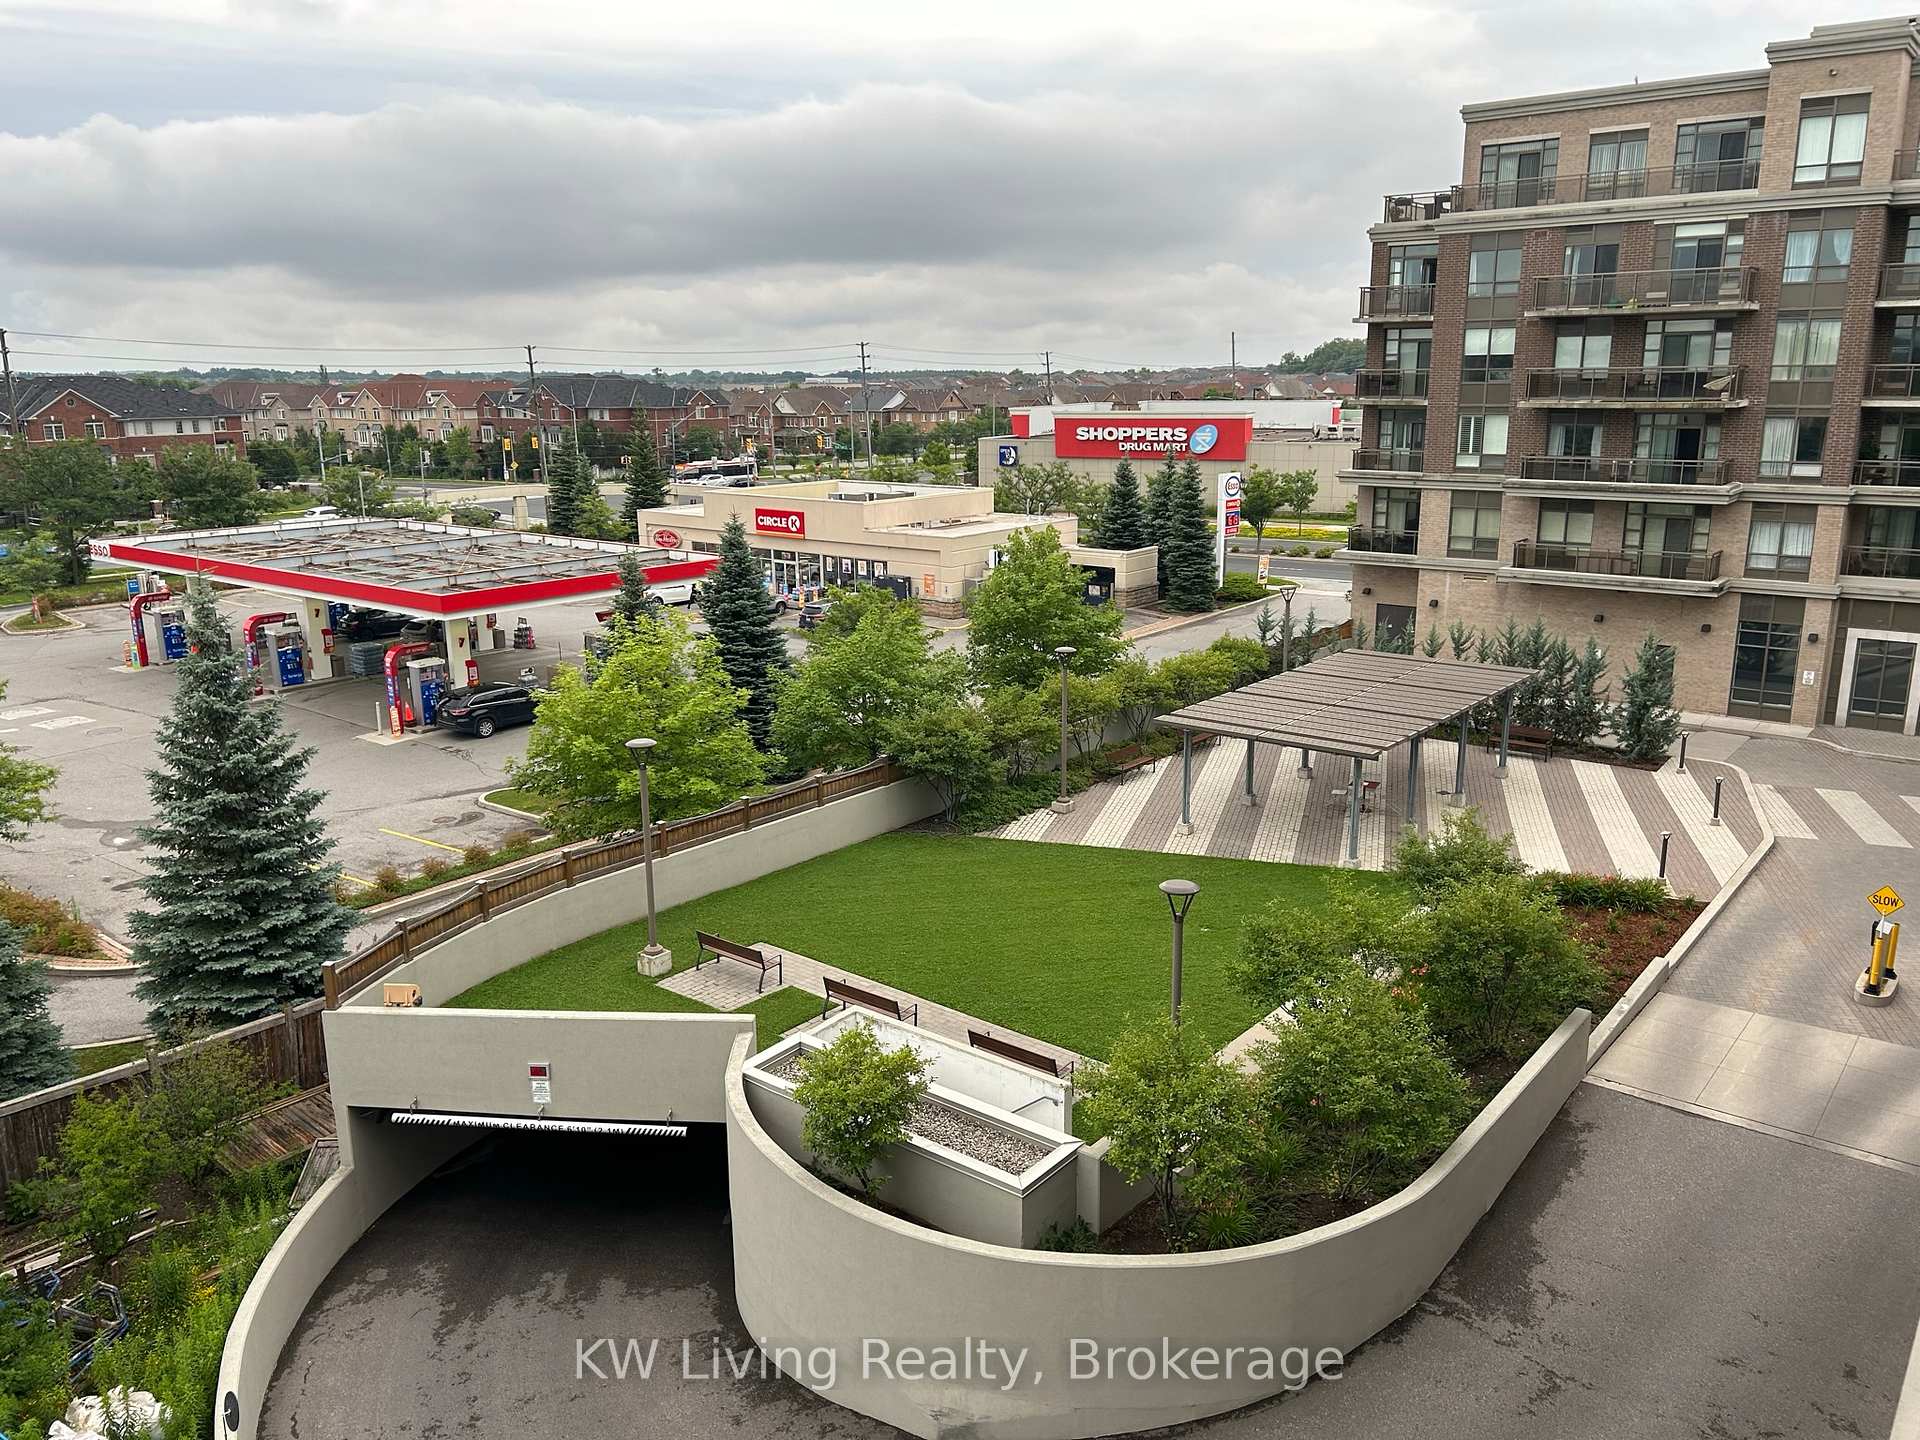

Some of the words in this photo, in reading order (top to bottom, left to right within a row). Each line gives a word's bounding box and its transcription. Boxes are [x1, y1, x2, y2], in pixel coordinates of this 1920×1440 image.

[1076, 427, 1188, 441] SHOPPERS
[1119, 442, 1152, 452] DRUG
[1153, 443, 1188, 452] MART
[757, 515, 788, 528] CIRCLE
[789, 515, 800, 531] K
[1872, 894, 1898, 907] SLOW
[503, 1122, 564, 1132] CLEARANCE
